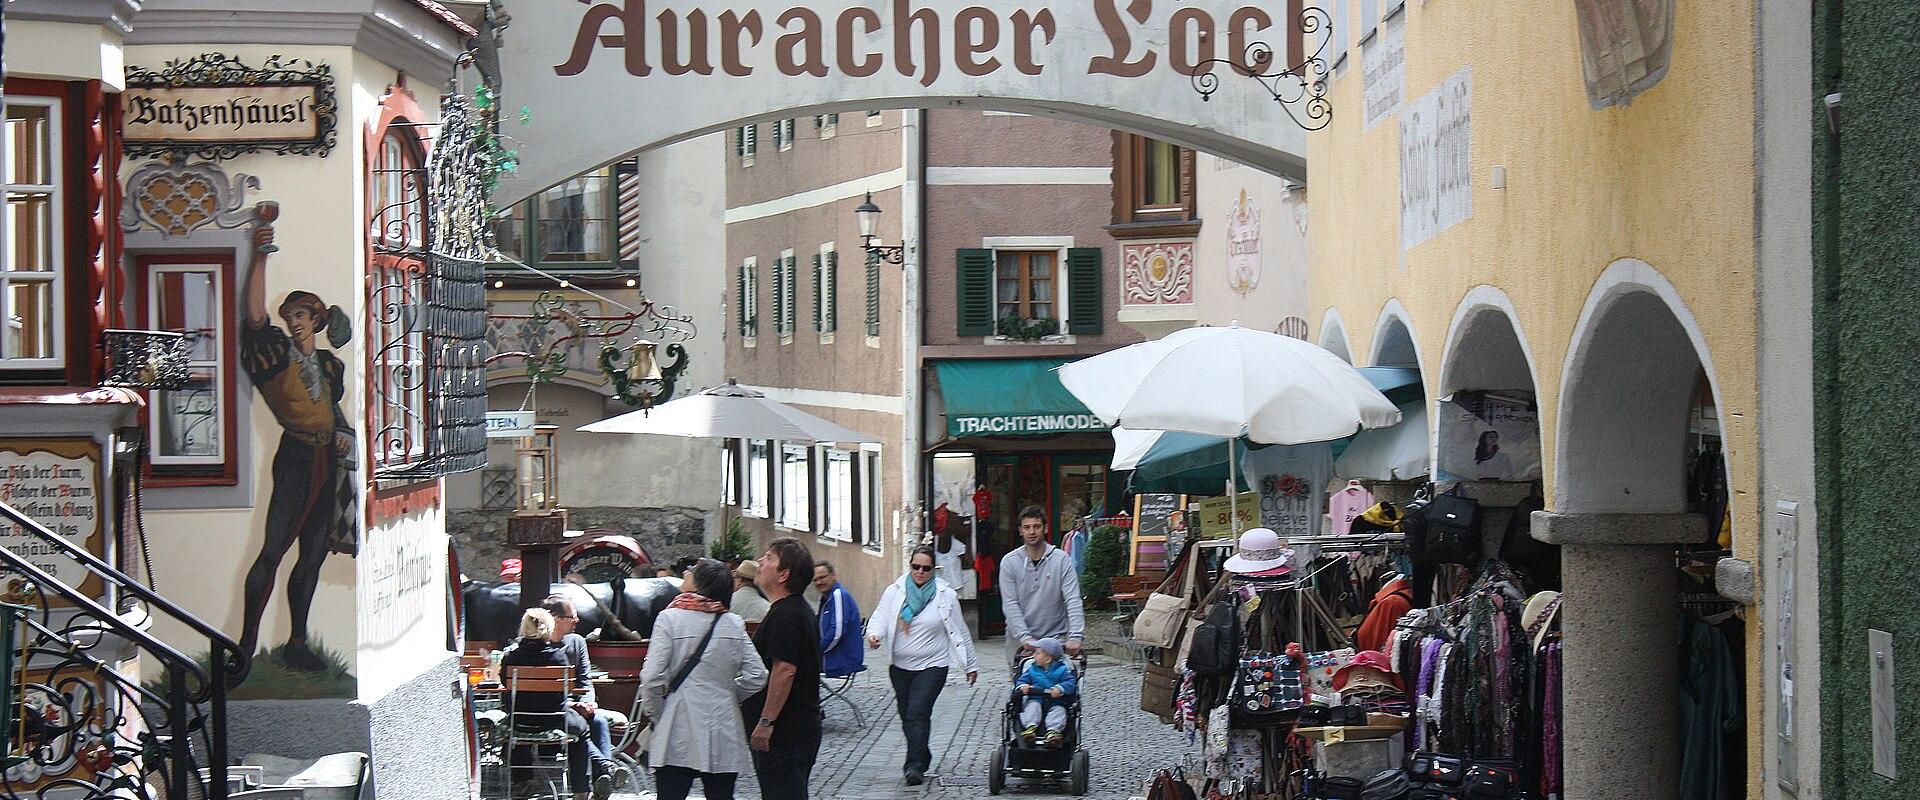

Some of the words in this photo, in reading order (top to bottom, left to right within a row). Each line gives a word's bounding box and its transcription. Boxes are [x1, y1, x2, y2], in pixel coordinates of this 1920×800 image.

[554, 0, 1056, 87] Auracher
[128, 94, 311, 132] Batzenhäusl
[956, 414, 1104, 433] TRACHTENMODE
[33, 464, 49, 479] der
[41, 482, 57, 497] der
